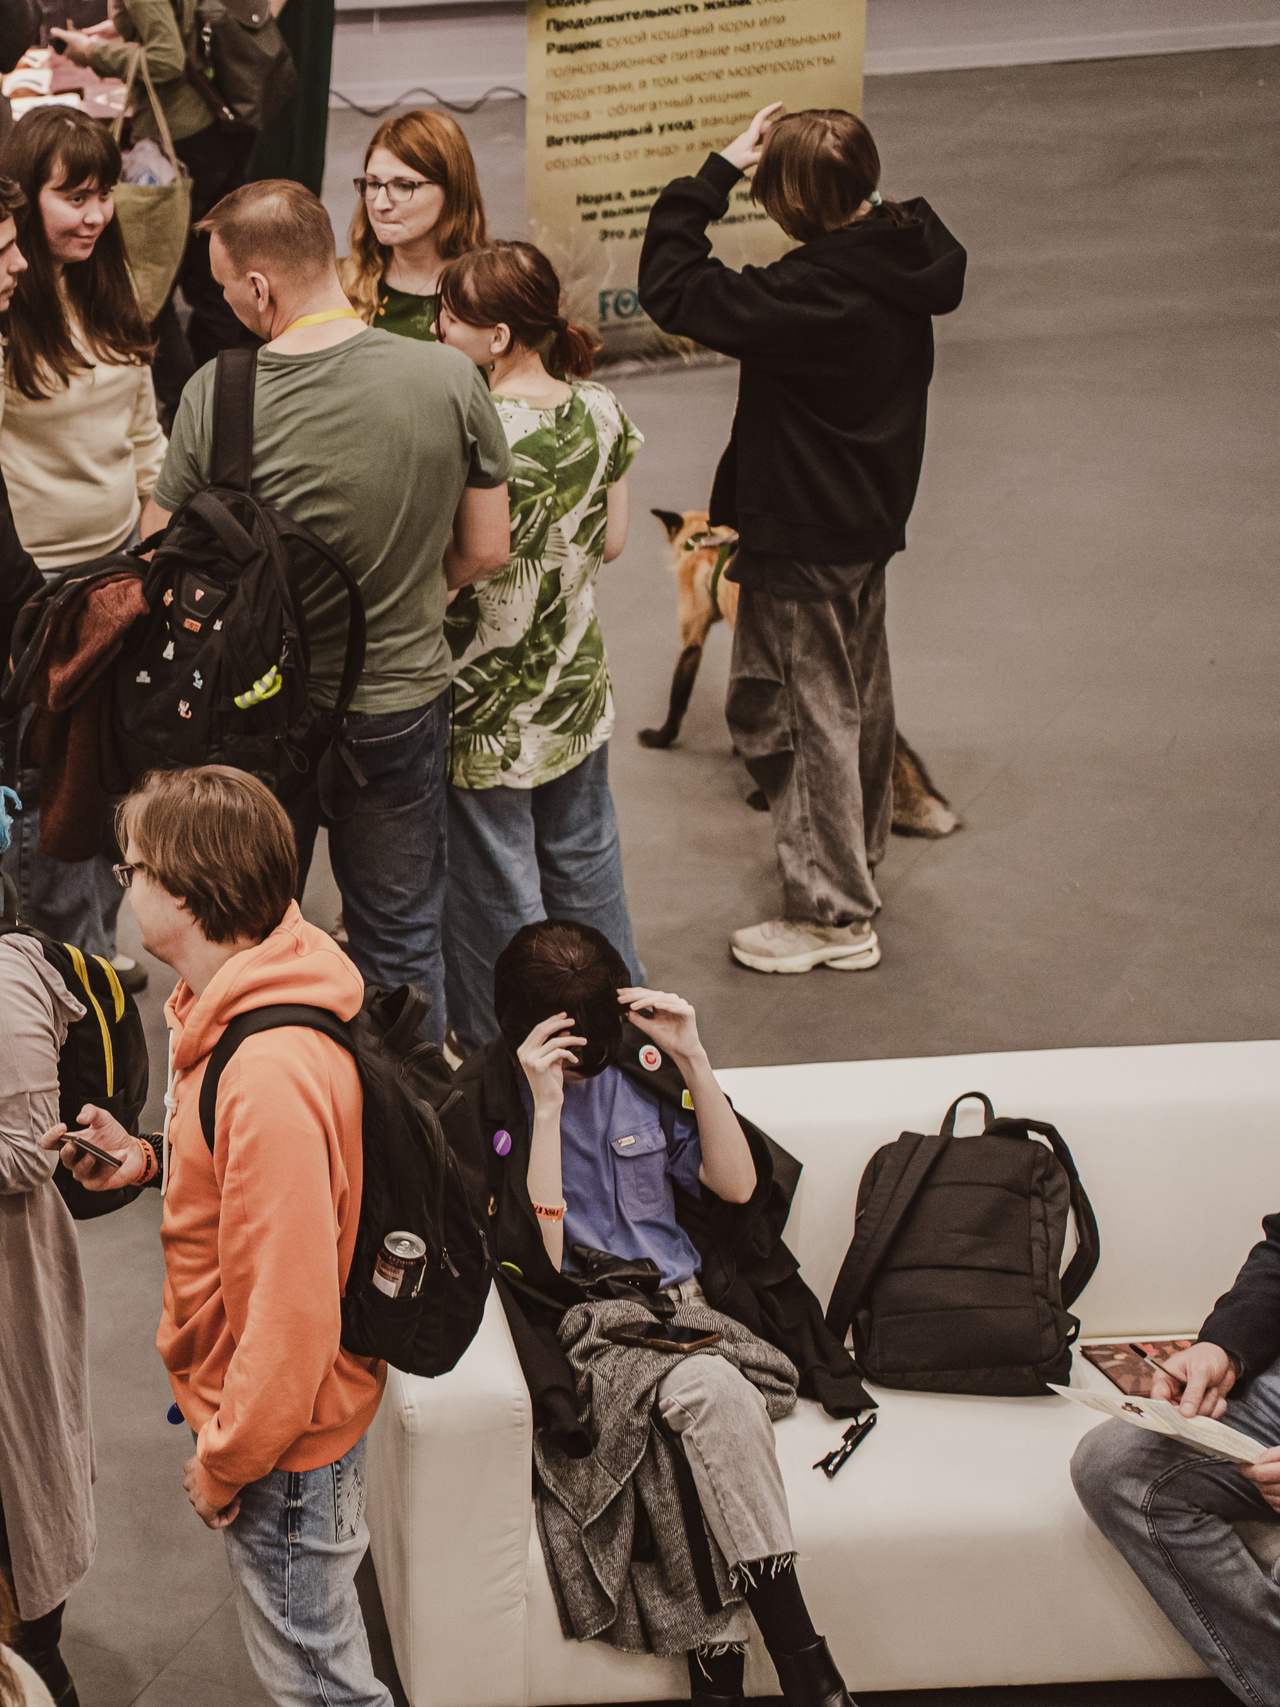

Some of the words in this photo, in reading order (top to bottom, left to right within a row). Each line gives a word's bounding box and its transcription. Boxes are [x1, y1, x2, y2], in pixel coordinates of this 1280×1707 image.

[718, 19, 754, 33] корм
[671, 44, 730, 62] питание
[733, 30, 841, 54] натуральными
[652, 75, 679, 88] том
[681, 68, 724, 83] числе
[546, 122, 653, 148] Ветеринарный
[598, 288, 642, 321] FO
